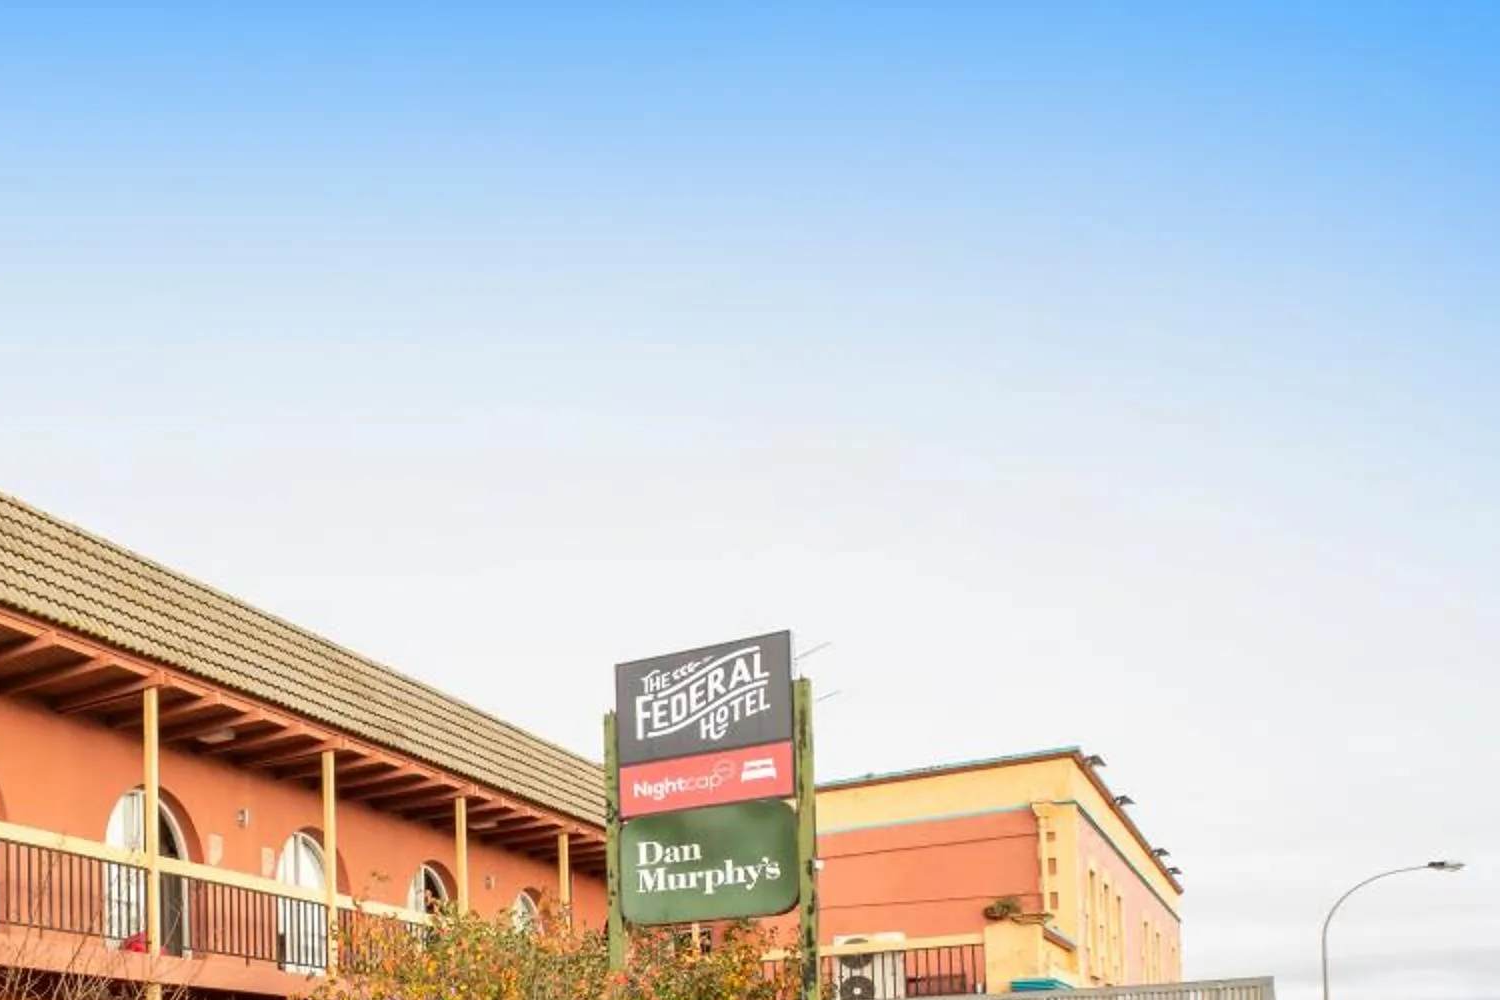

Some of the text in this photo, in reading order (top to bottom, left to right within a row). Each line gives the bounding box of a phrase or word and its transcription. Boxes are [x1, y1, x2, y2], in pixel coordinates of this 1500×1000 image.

[635, 652, 770, 741] FEDERAL
[640, 669, 671, 694] THE
[700, 688, 771, 740] HOTEL
[636, 841, 702, 867] Dan
[635, 857, 781, 894] Murphy's
